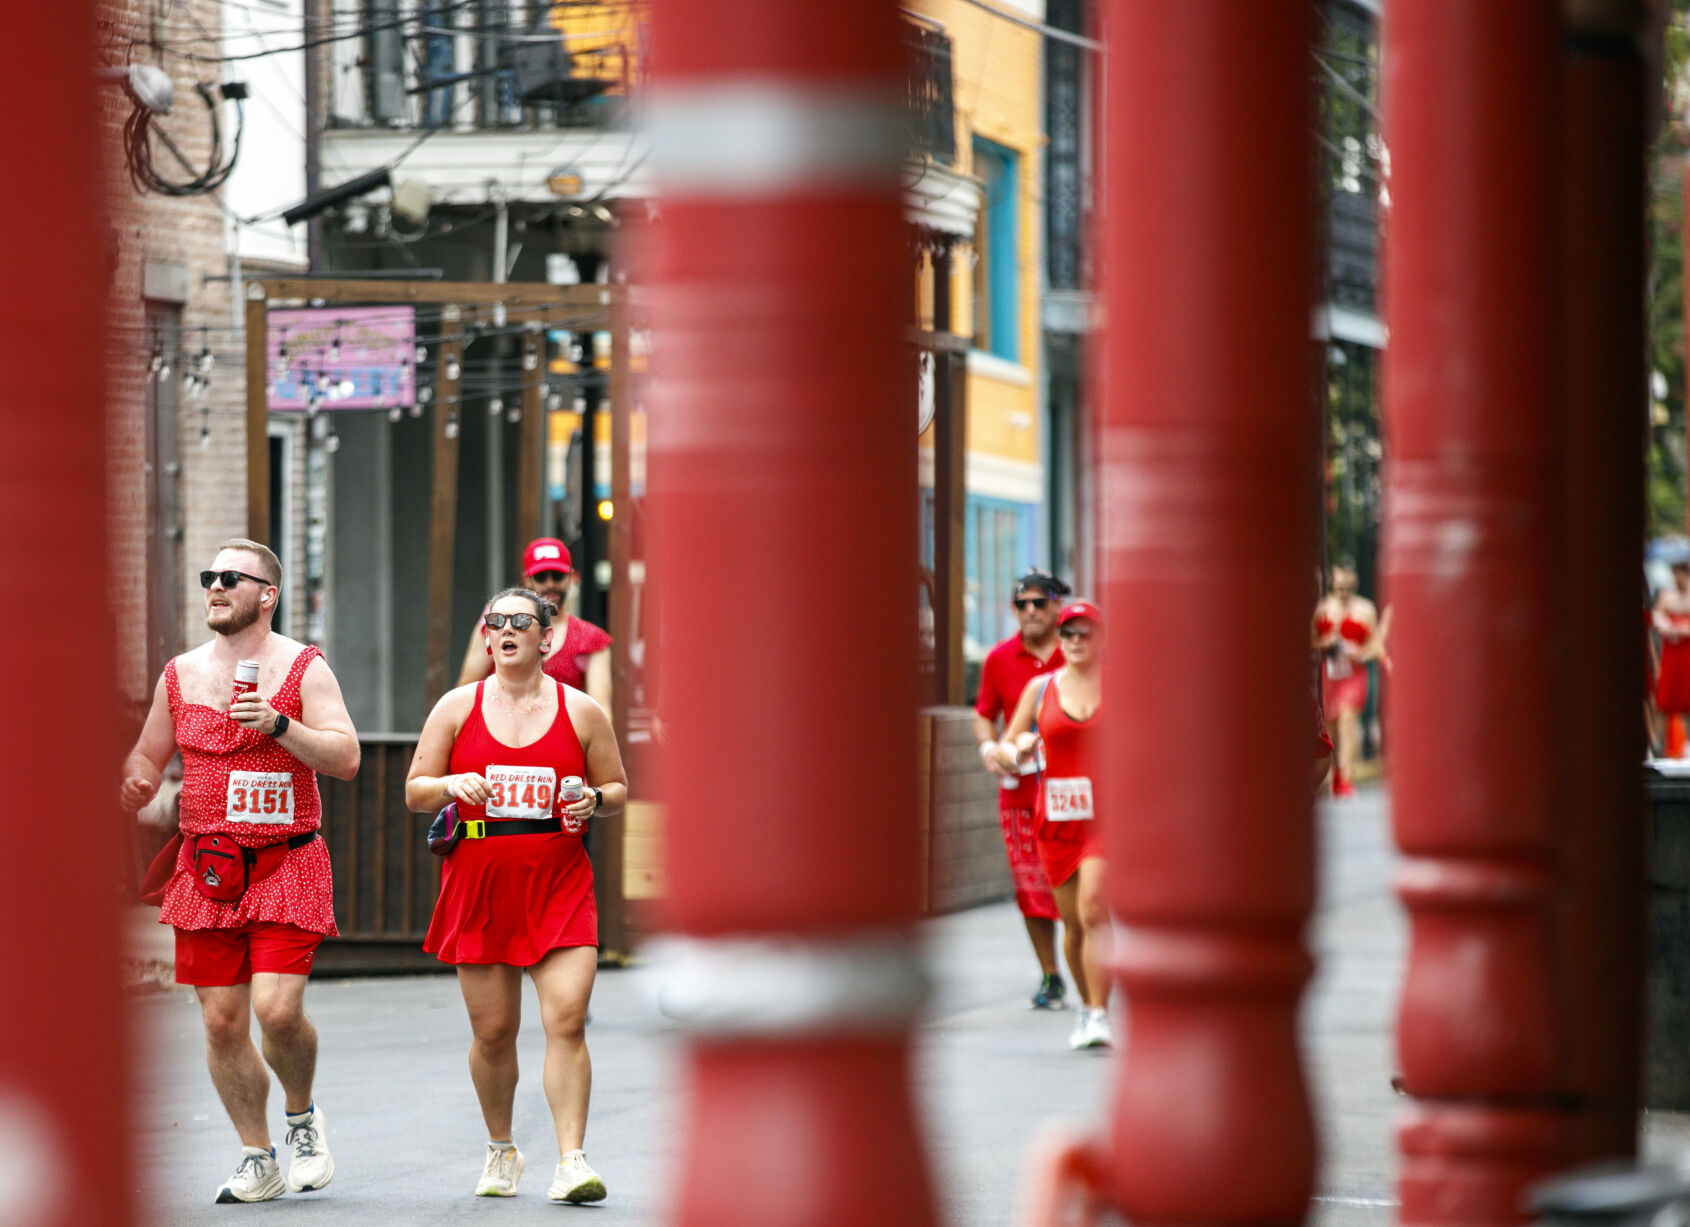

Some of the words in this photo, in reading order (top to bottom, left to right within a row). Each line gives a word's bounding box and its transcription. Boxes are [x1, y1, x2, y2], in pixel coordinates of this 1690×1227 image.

[233, 779, 249, 787] RED
[251, 780, 277, 788] DRESS
[490, 773, 506, 782] RED
[509, 774, 535, 782] DRESS
[538, 775, 553, 783] RUN
[233, 788, 288, 814] 3151
[491, 782, 551, 809] 3149
